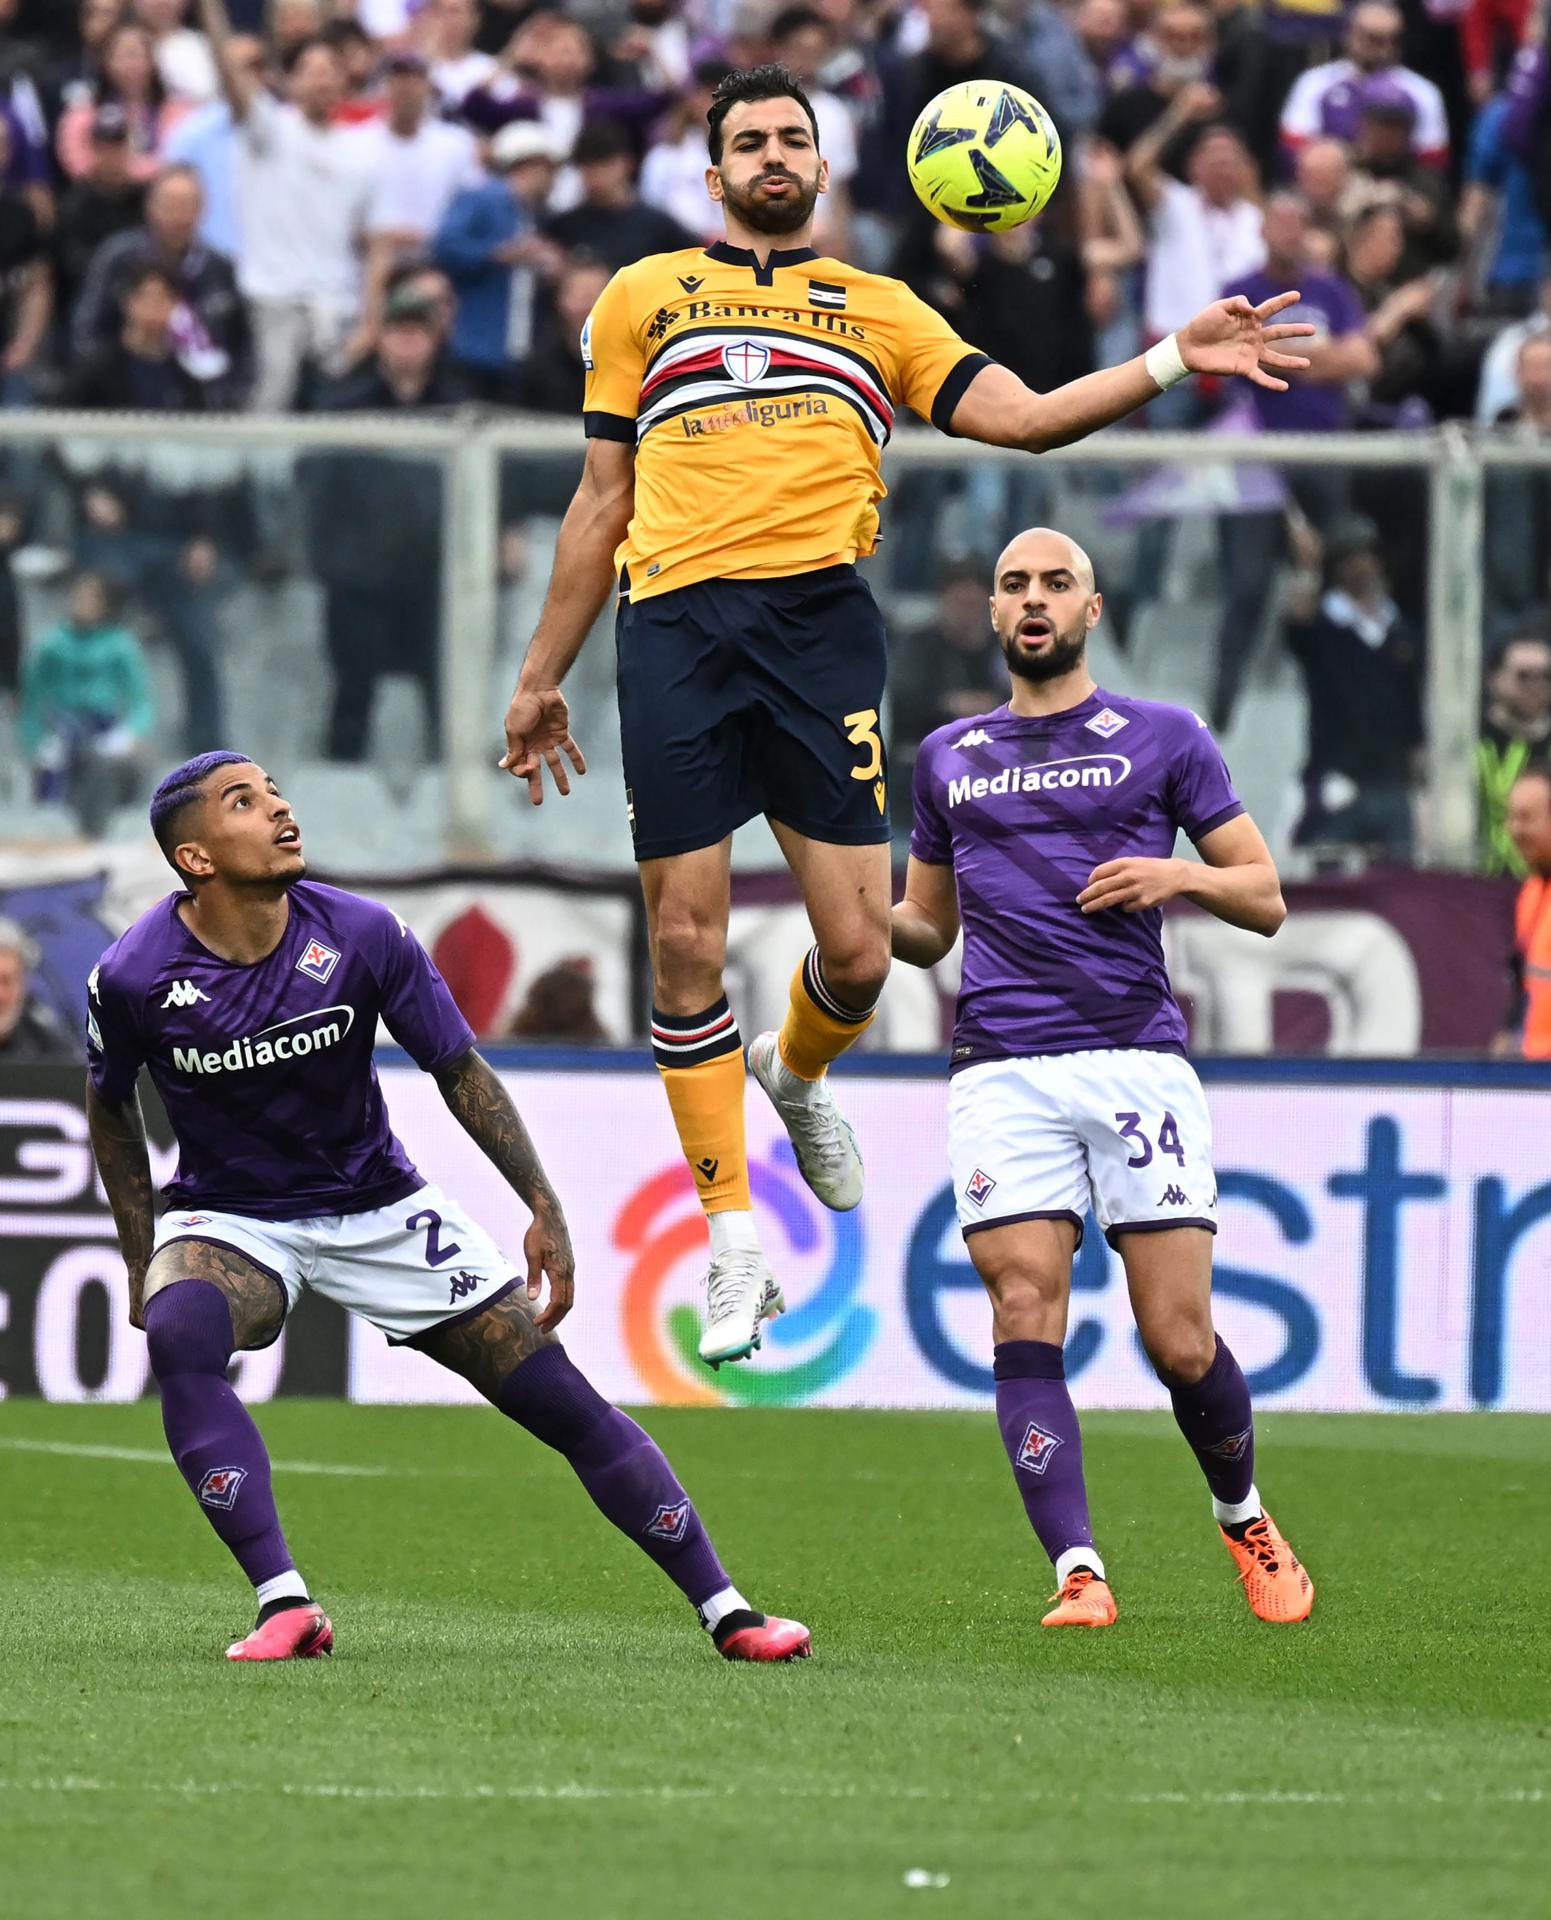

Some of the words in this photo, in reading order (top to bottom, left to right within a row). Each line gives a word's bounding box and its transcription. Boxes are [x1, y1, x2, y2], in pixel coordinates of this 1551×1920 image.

[688, 301, 800, 322] Banca
[843, 708, 883, 780] 3
[948, 766, 1113, 808] Mediacom
[172, 1020, 341, 1075] Mediacom
[1115, 1111, 1186, 1168] 34
[406, 1209, 461, 1268] 2
